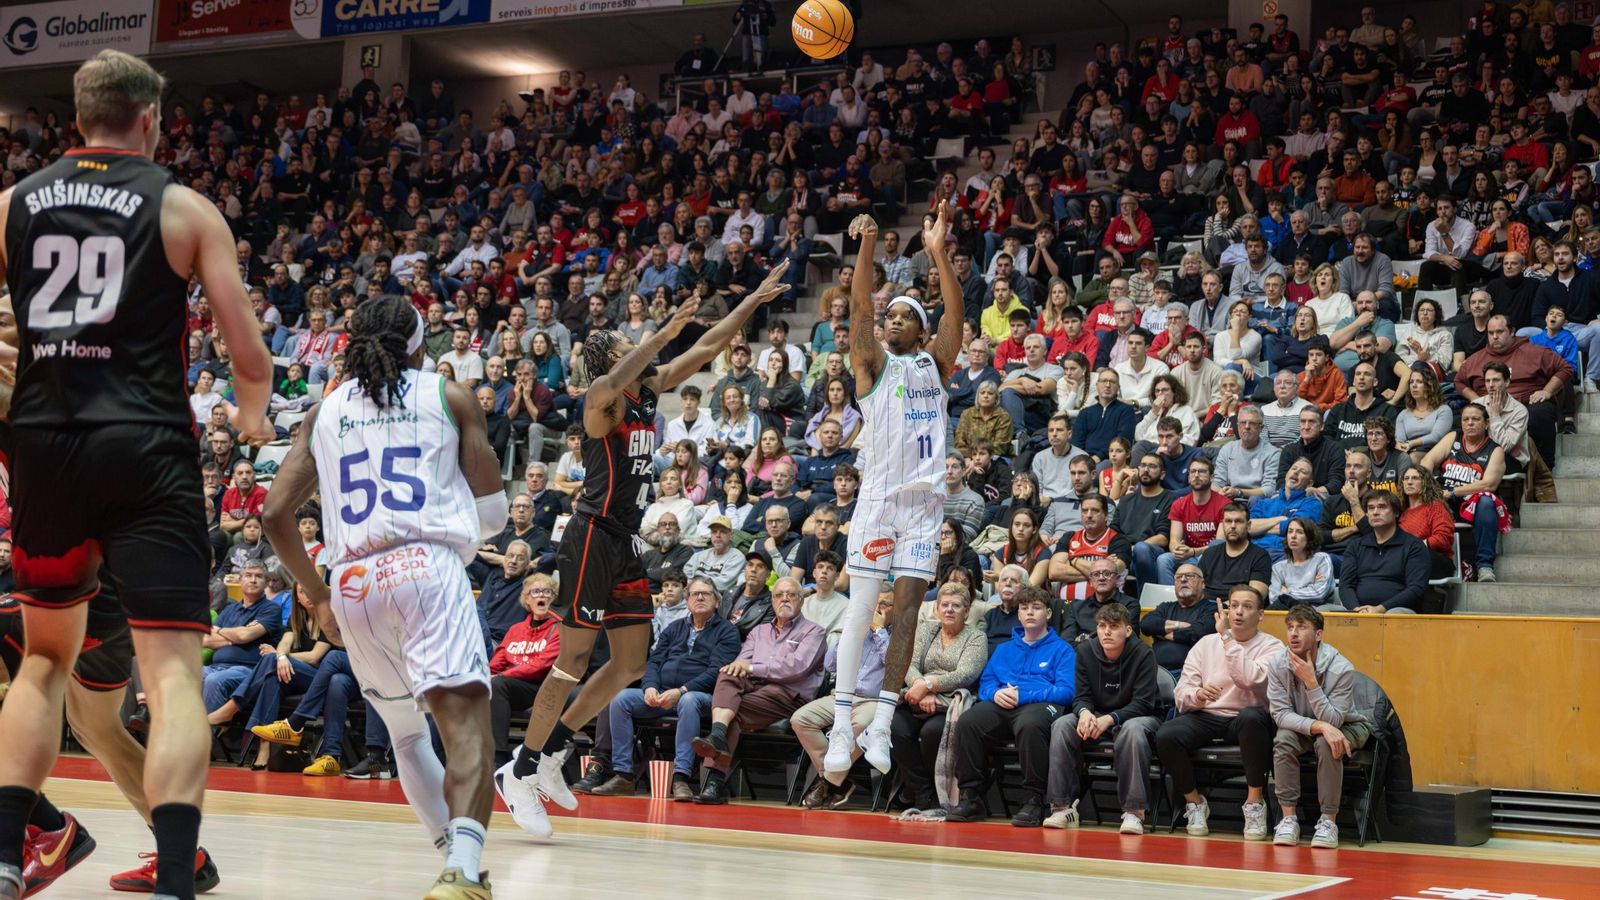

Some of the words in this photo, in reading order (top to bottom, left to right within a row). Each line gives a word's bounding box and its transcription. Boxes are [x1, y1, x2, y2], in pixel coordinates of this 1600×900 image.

[413, 17, 438, 27] way
[498, 8, 532, 19] serveis
[534, 4, 577, 17] integrals
[46, 11, 147, 37] Globalimar
[25, 178, 143, 218] SUŠINSKAS
[28, 235, 126, 328] 29
[61, 340, 112, 359] Home
[918, 435, 932, 459] 11
[340, 447, 426, 525] 55
[1186, 521, 1217, 533] GIRONA
[376, 546, 428, 568] COSTA
[376, 566, 398, 582] DEL
[401, 560, 428, 571] SOL
